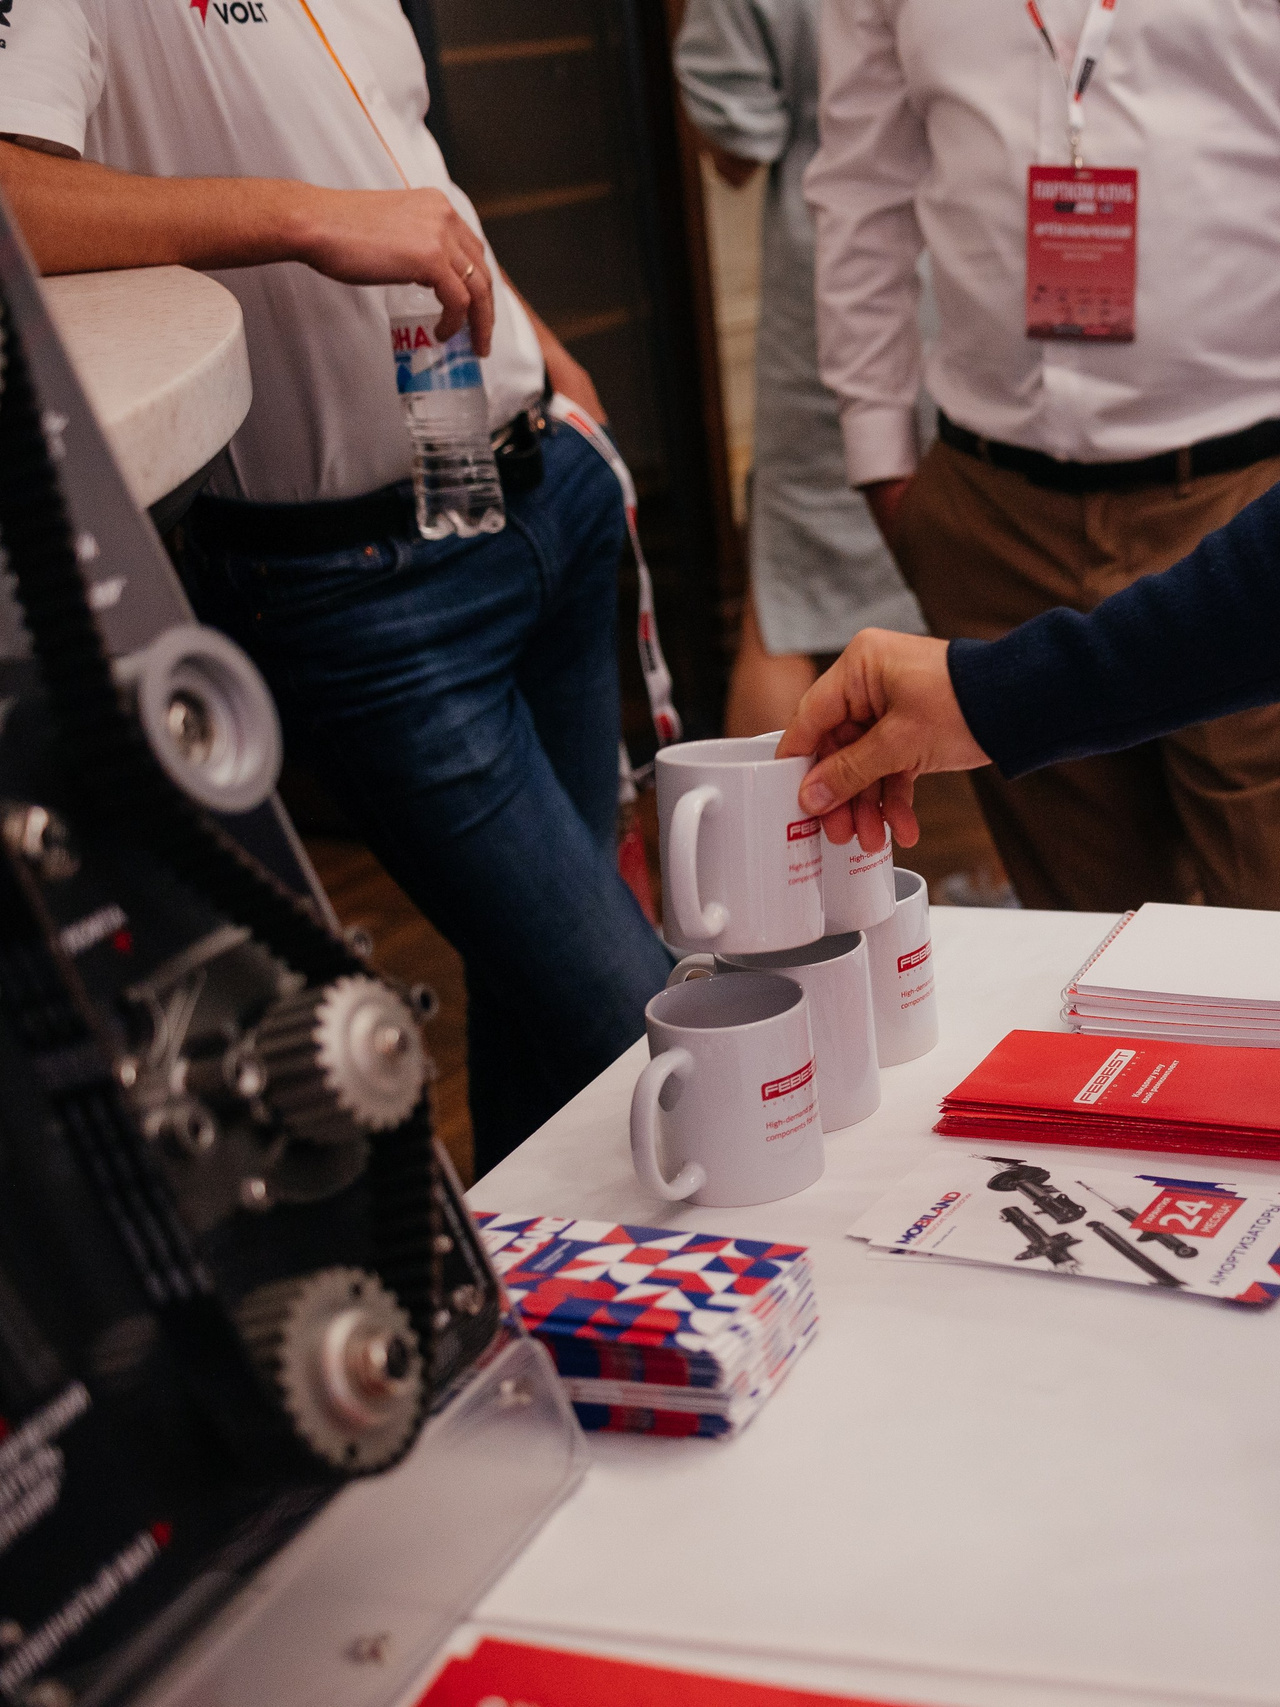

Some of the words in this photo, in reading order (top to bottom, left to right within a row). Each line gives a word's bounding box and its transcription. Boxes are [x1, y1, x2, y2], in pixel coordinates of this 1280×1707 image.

[213, 2, 268, 24] VOLT
[1080, 1051, 1129, 1103] FEBEST
[895, 1191, 961, 1245] MOBILAND
[1158, 1200, 1214, 1231] 24
